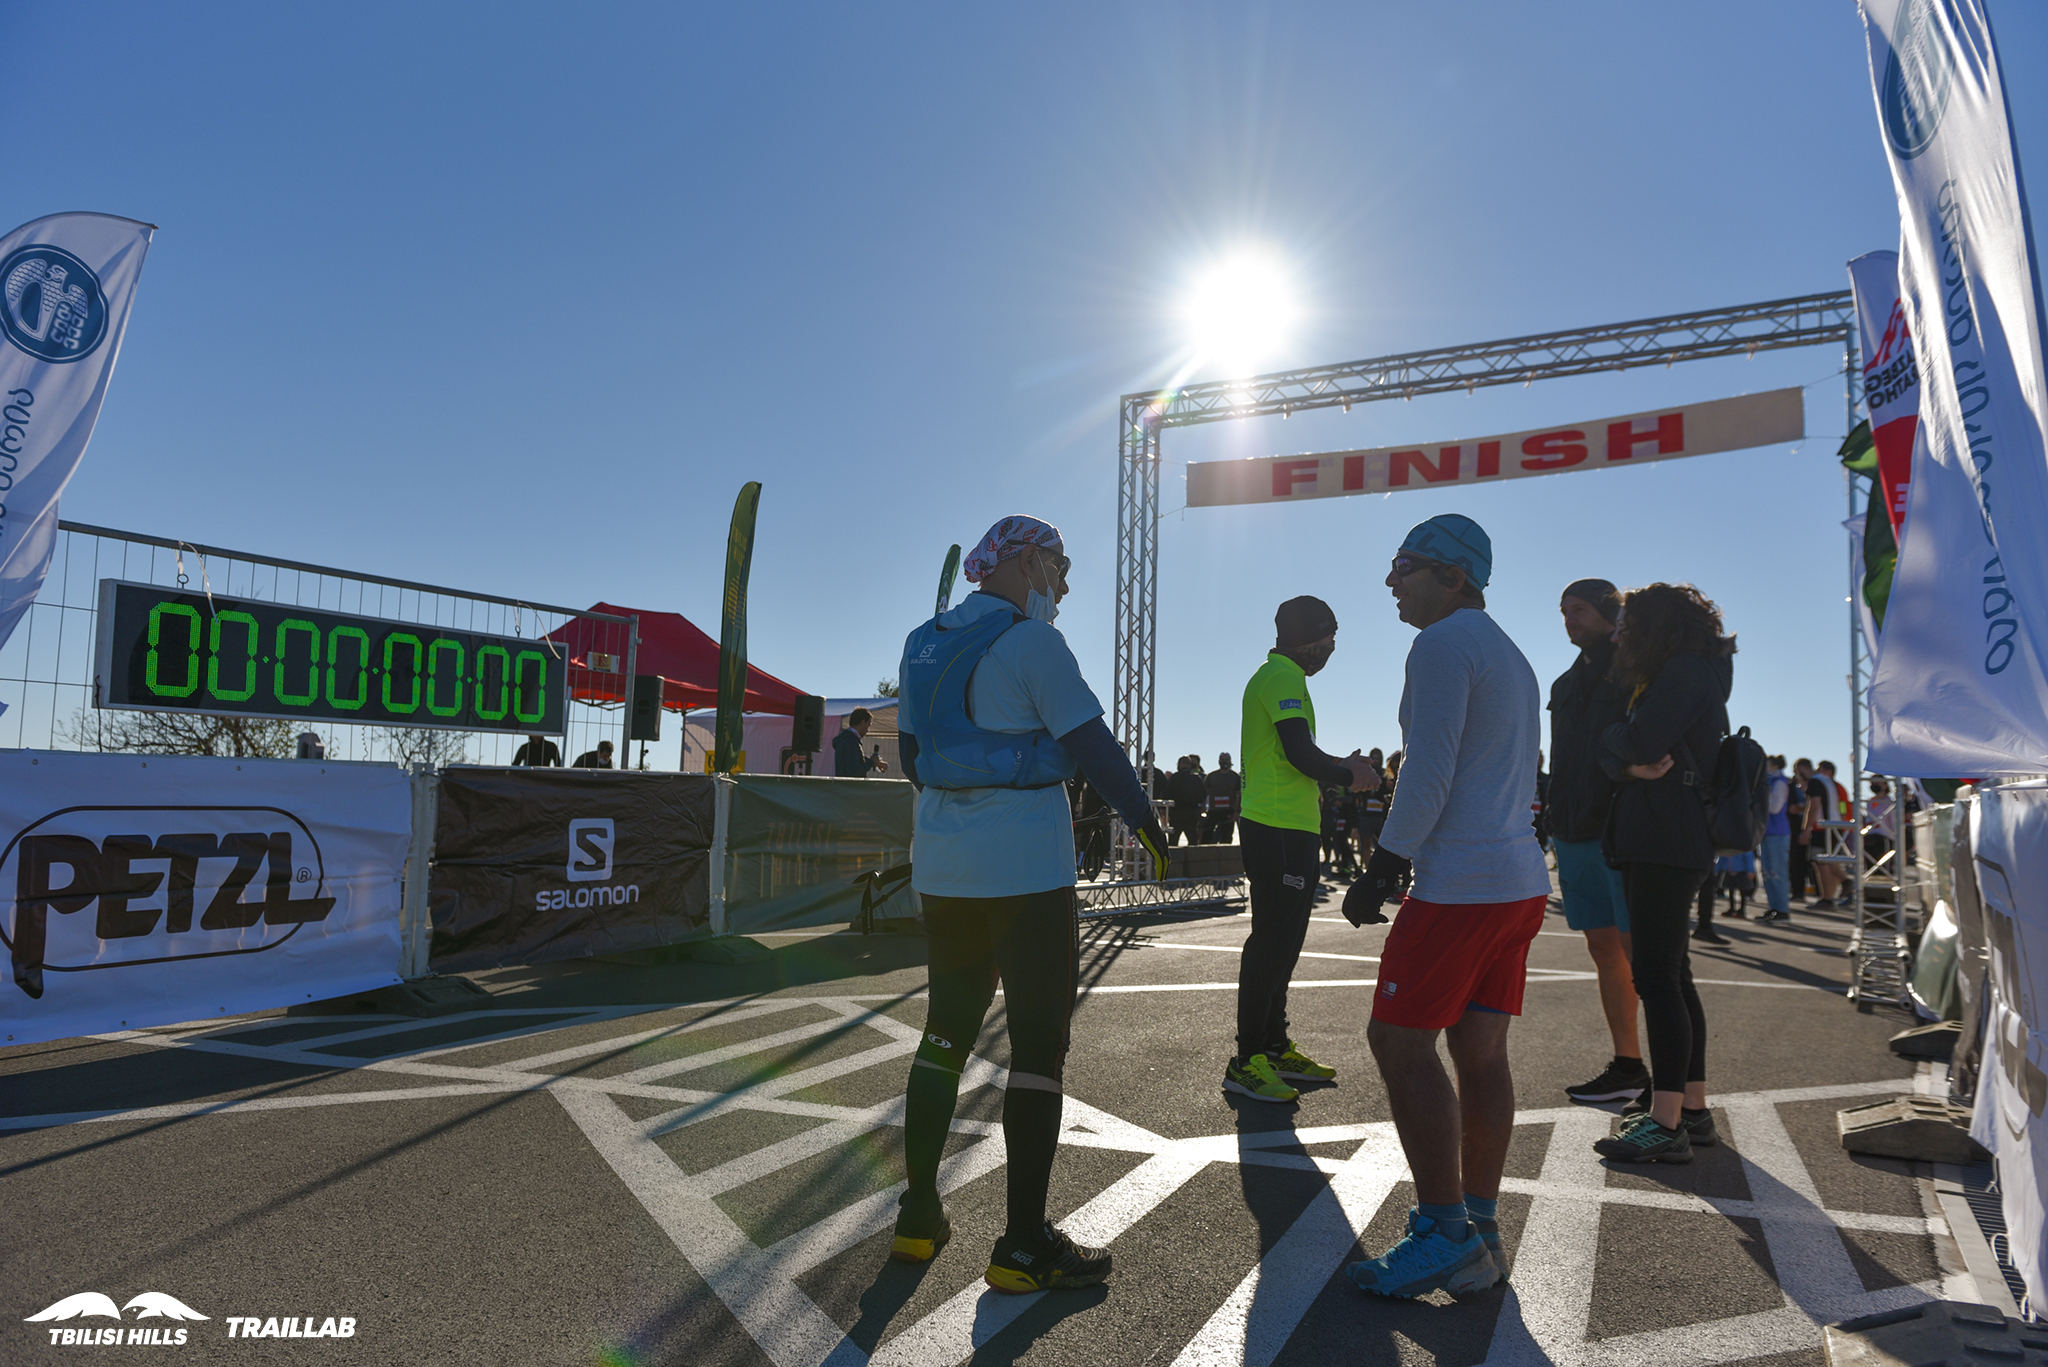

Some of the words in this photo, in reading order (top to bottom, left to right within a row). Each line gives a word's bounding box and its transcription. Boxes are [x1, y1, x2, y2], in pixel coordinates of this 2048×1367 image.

[1272, 412, 1685, 497] FINISH
[767, 822, 832, 850] TBILISI
[12, 831, 337, 999] PETZL
[535, 884, 640, 911] salomon
